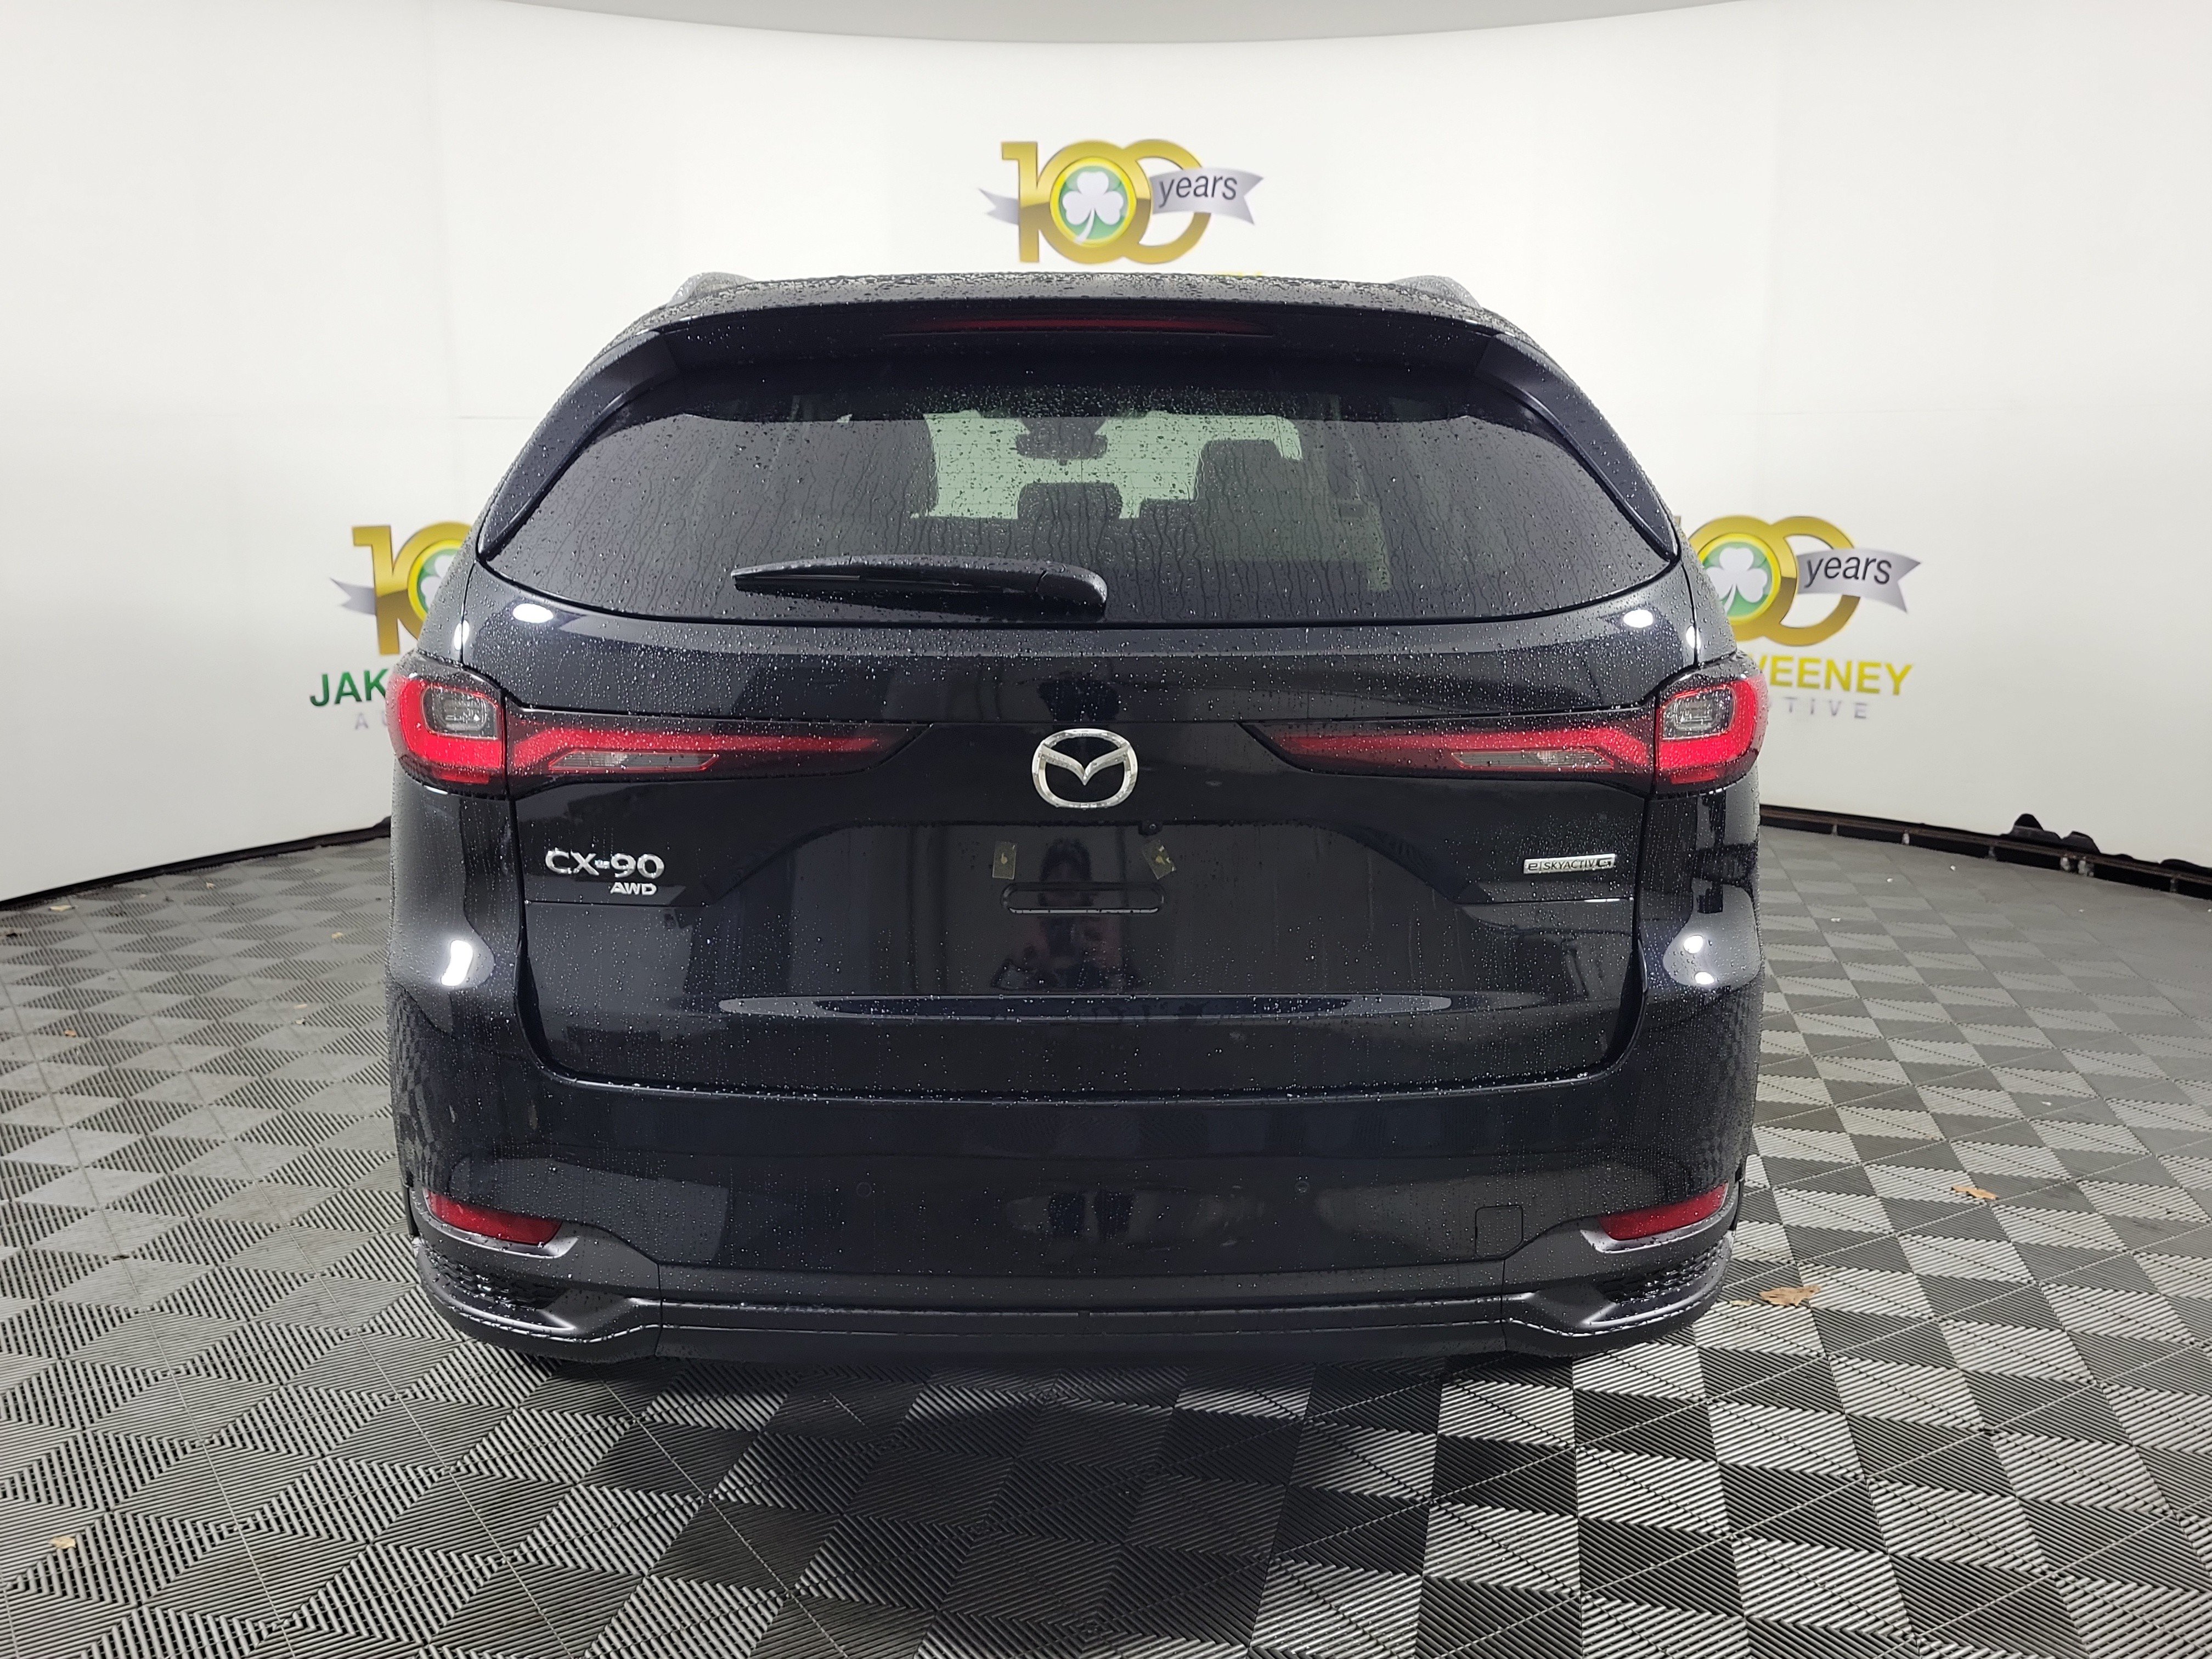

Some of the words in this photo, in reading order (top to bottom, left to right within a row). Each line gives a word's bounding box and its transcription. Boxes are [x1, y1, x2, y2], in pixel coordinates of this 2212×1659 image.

[1001, 139, 1211, 264] 100
[1159, 172, 1237, 208] years
[1676, 515, 1860, 647] 00
[1804, 554, 1892, 589] years
[545, 849, 664, 879] CX-90
[610, 882, 657, 895] AWD
